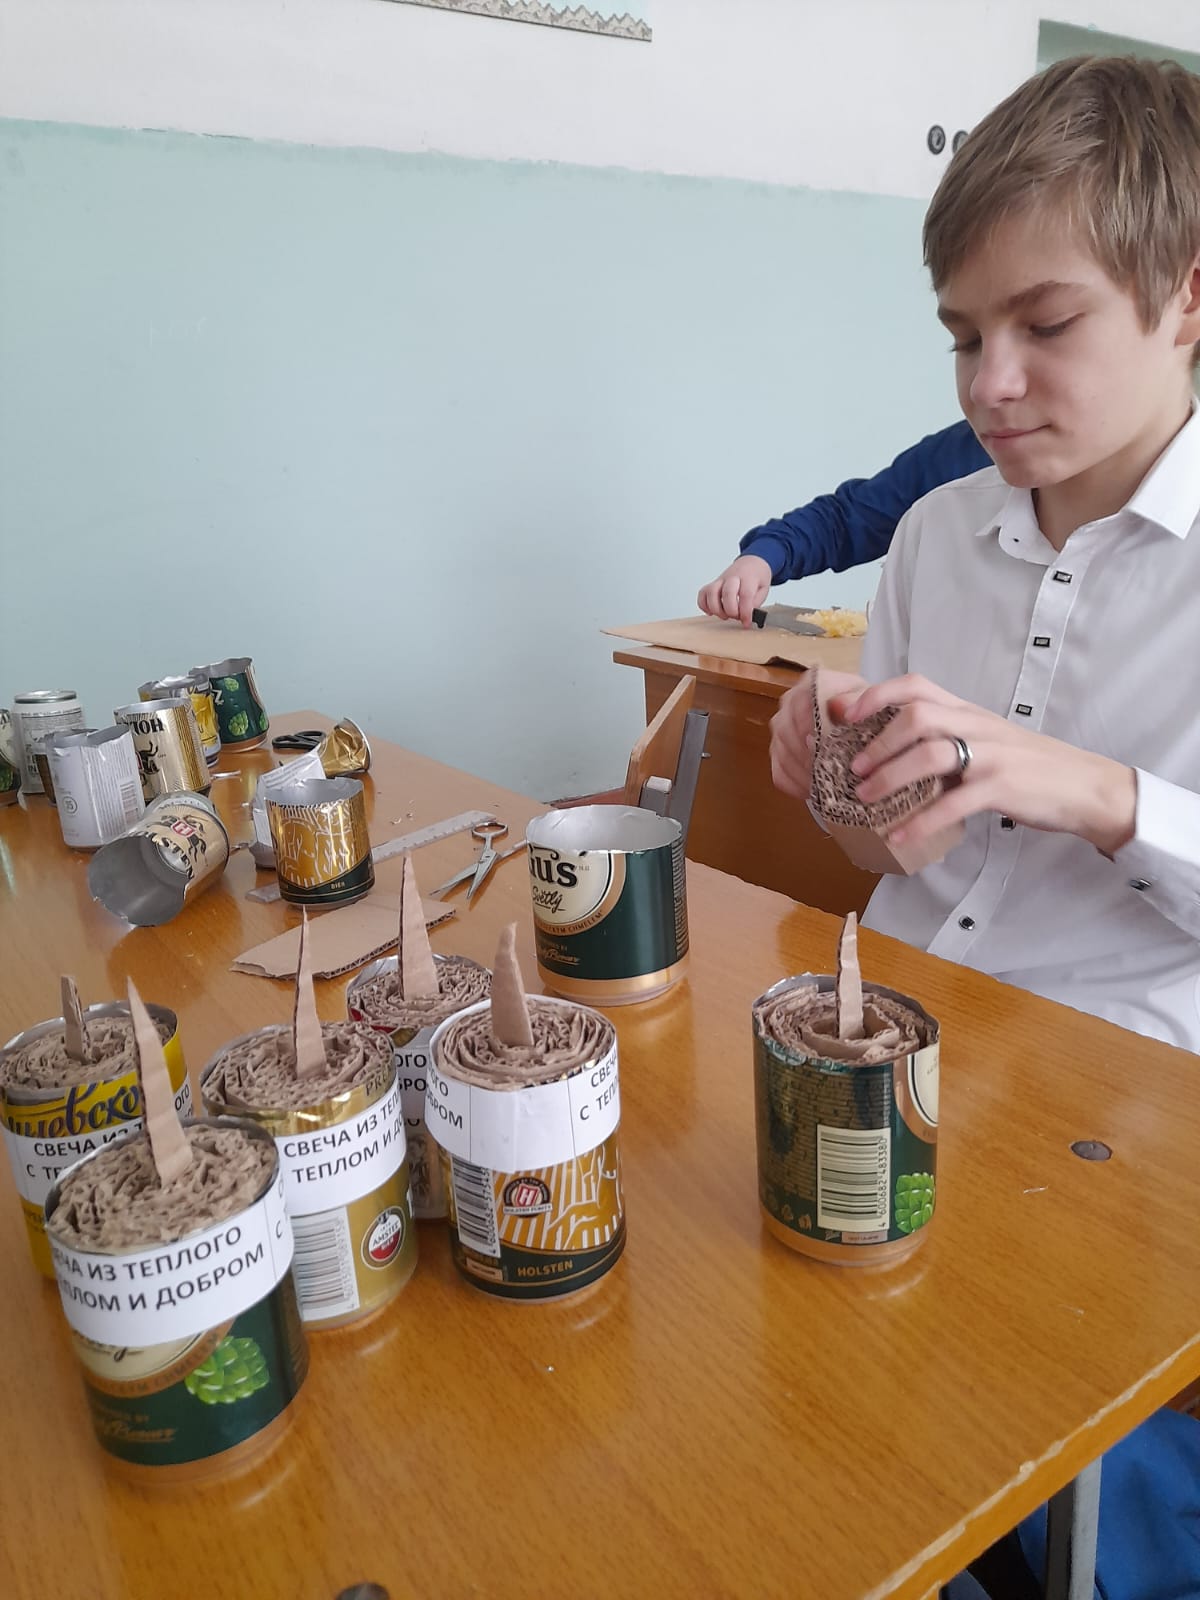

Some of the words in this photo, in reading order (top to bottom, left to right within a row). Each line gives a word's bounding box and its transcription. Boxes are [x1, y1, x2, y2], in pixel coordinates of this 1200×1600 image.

[579, 1104, 590, 1121] С
[34, 1138, 97, 1157] СВЕЧА
[283, 1128, 352, 1158] СВЕЧА
[356, 1114, 378, 1138] ИЗ
[26, 1163, 36, 1178] С
[292, 1140, 380, 1184] ТЕПЛОМ
[87, 1262, 117, 1282] ИЗ
[122, 1226, 242, 1281] ТЕПЛОГО
[517, 1260, 573, 1277] HOLSTEN
[128, 1292, 147, 1311] И
[156, 1242, 264, 1311] ДОБРОМ
